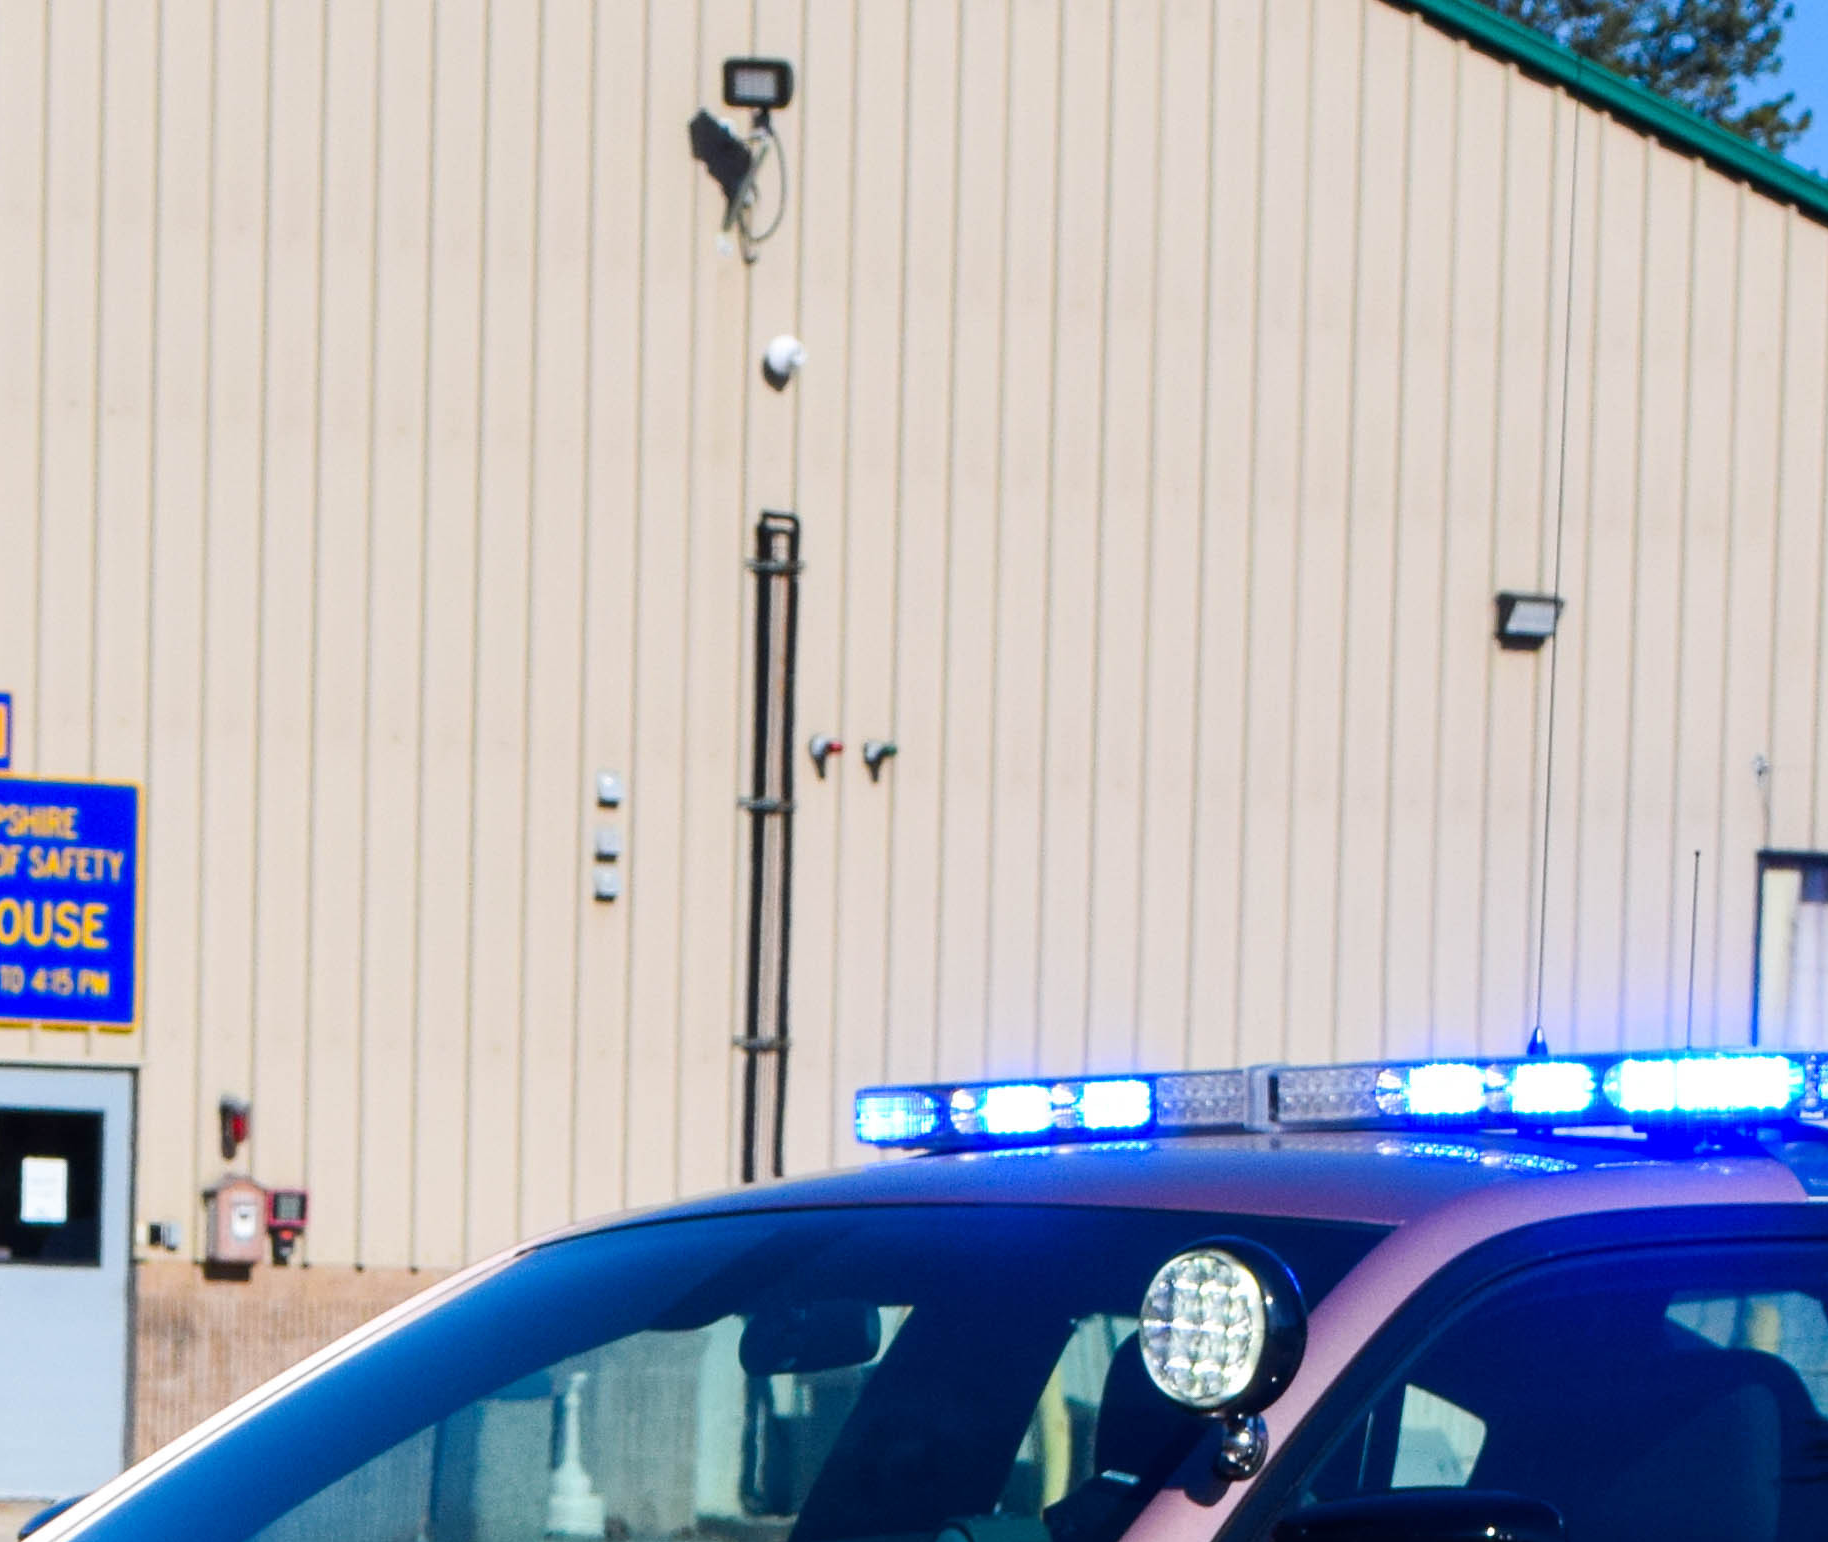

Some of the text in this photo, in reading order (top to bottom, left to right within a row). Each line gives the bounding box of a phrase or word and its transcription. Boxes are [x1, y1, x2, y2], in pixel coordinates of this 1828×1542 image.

[28, 845, 124, 883] SAFETY
[31, 967, 73, 996] 4:15
[76, 969, 110, 996] PM
